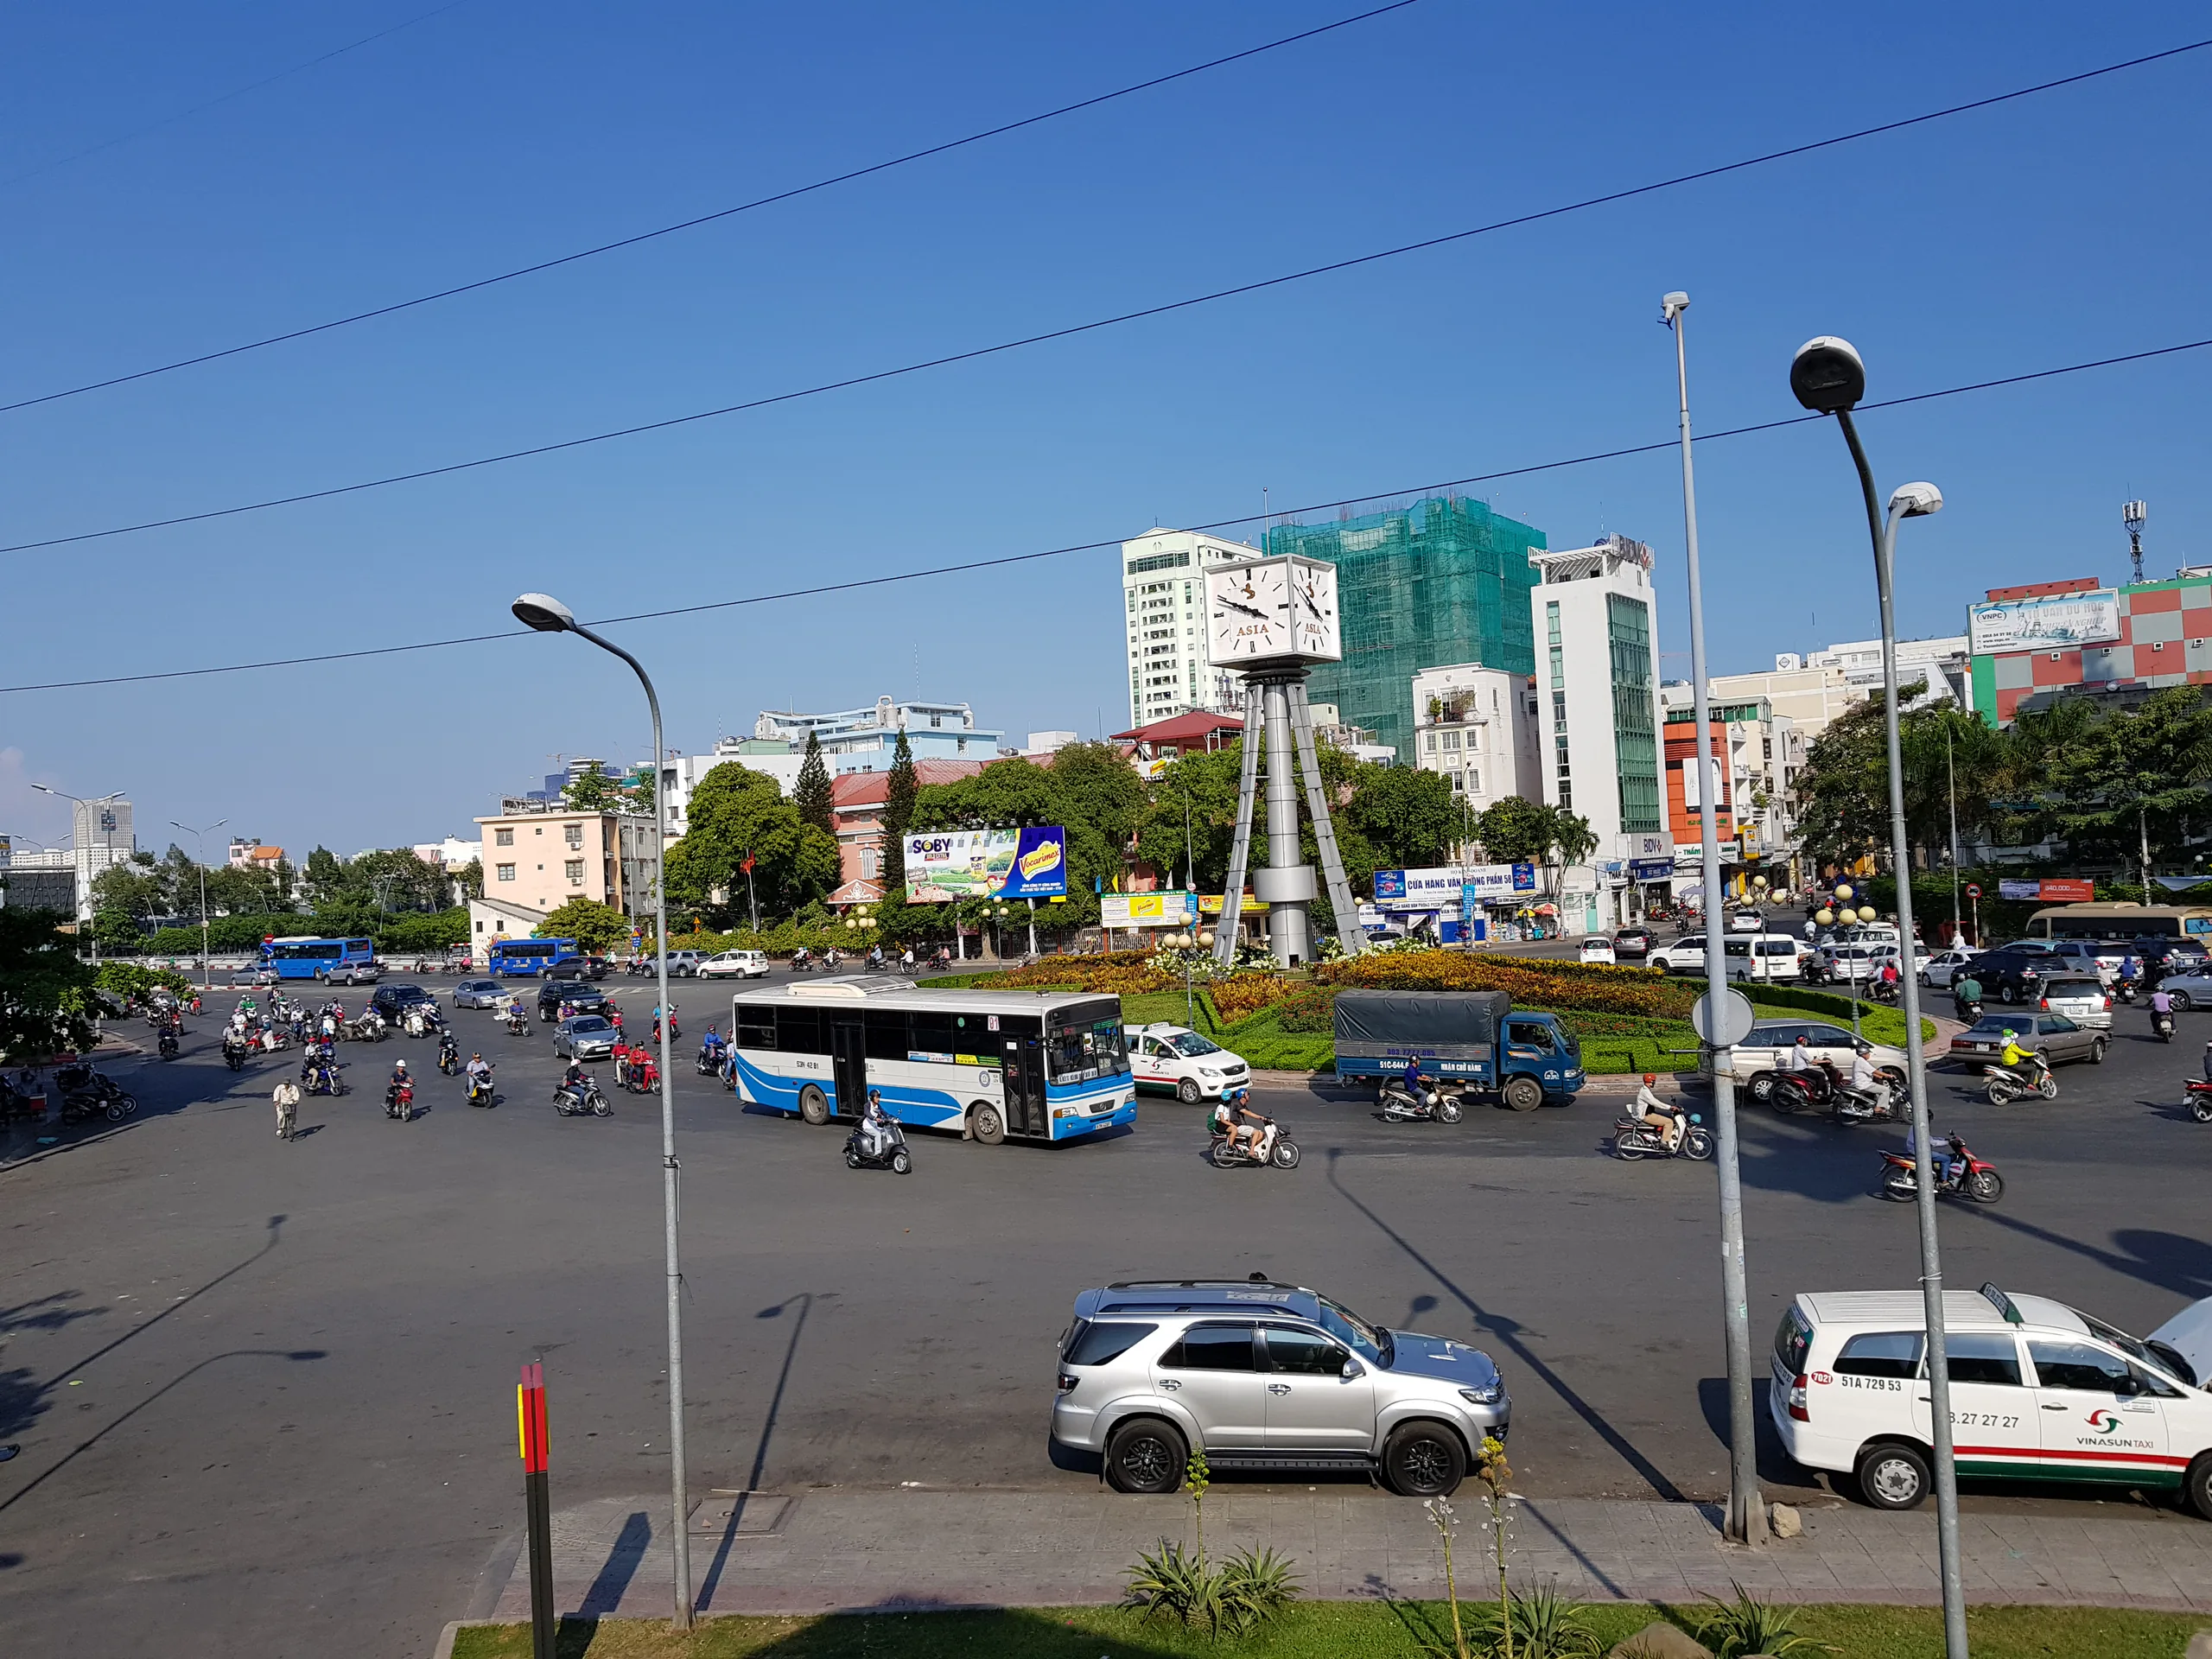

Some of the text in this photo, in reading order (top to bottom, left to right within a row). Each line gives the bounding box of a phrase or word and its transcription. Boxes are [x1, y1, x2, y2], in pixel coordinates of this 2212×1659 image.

[1236, 624, 1269, 637] ASIA
[1305, 623, 1321, 634] ASIA
[912, 838, 950, 854] SOBY
[1643, 838, 1662, 854] BIDV
[1020, 850, 1059, 873] Vocarimex
[1408, 877, 1423, 890] CỬA
[1425, 878, 1445, 889] HÀNG
[1447, 877, 1461, 888] VĂN
[1486, 872, 1503, 885] PHẨM
[1504, 874, 1512, 883] 58
[1813, 1372, 1832, 1383] 7021
[1841, 1376, 1902, 1391] 51A 729 53
[1982, 1414, 1999, 1427] 27
[2002, 1416, 2019, 1428] 27
